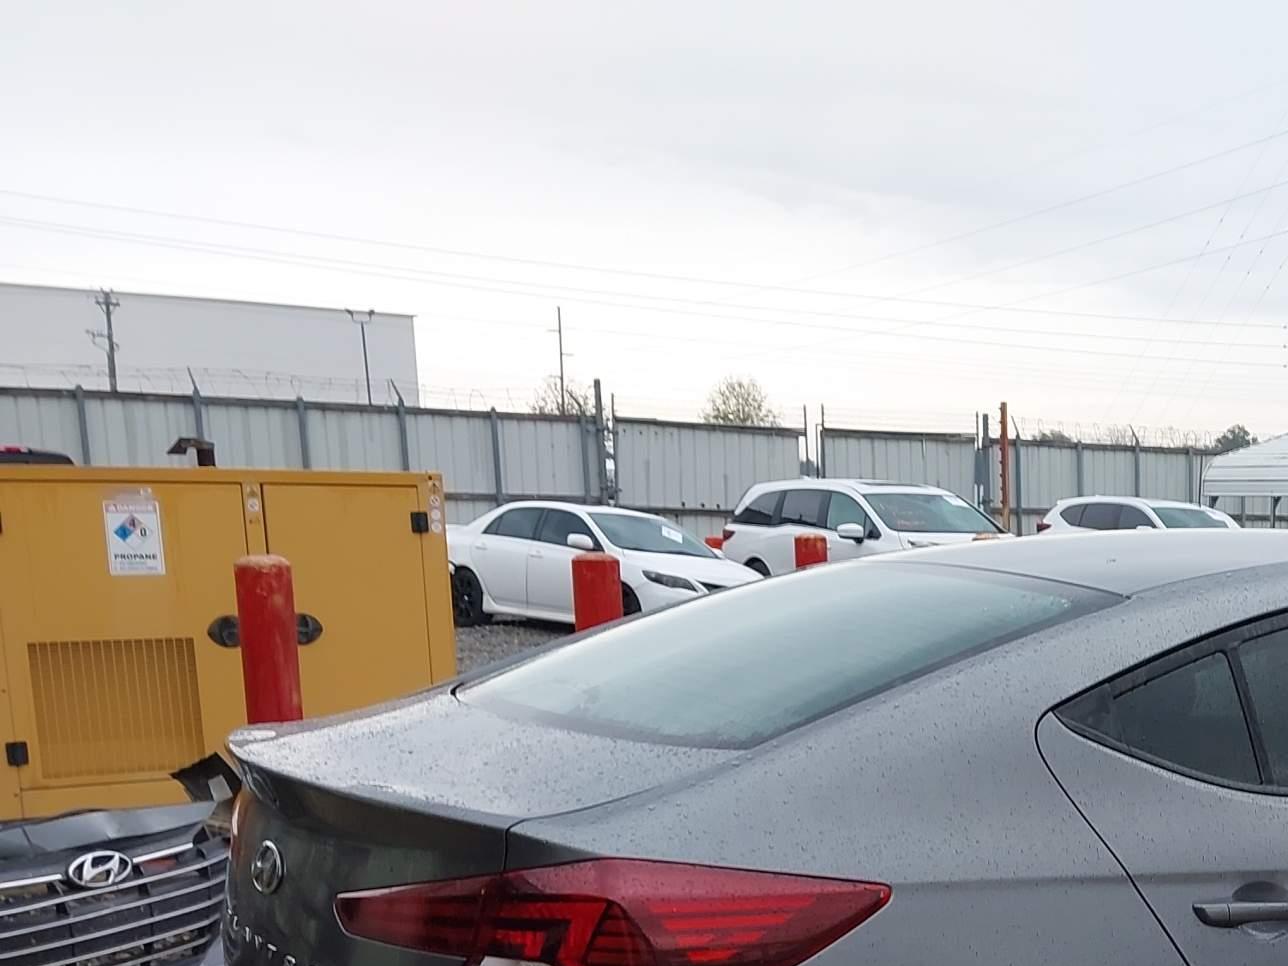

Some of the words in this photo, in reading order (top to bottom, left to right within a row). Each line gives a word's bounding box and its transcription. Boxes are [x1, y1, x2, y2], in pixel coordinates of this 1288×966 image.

[128, 518, 136, 529] 4
[140, 527, 147, 538] 0
[114, 553, 158, 561] PROPANE
